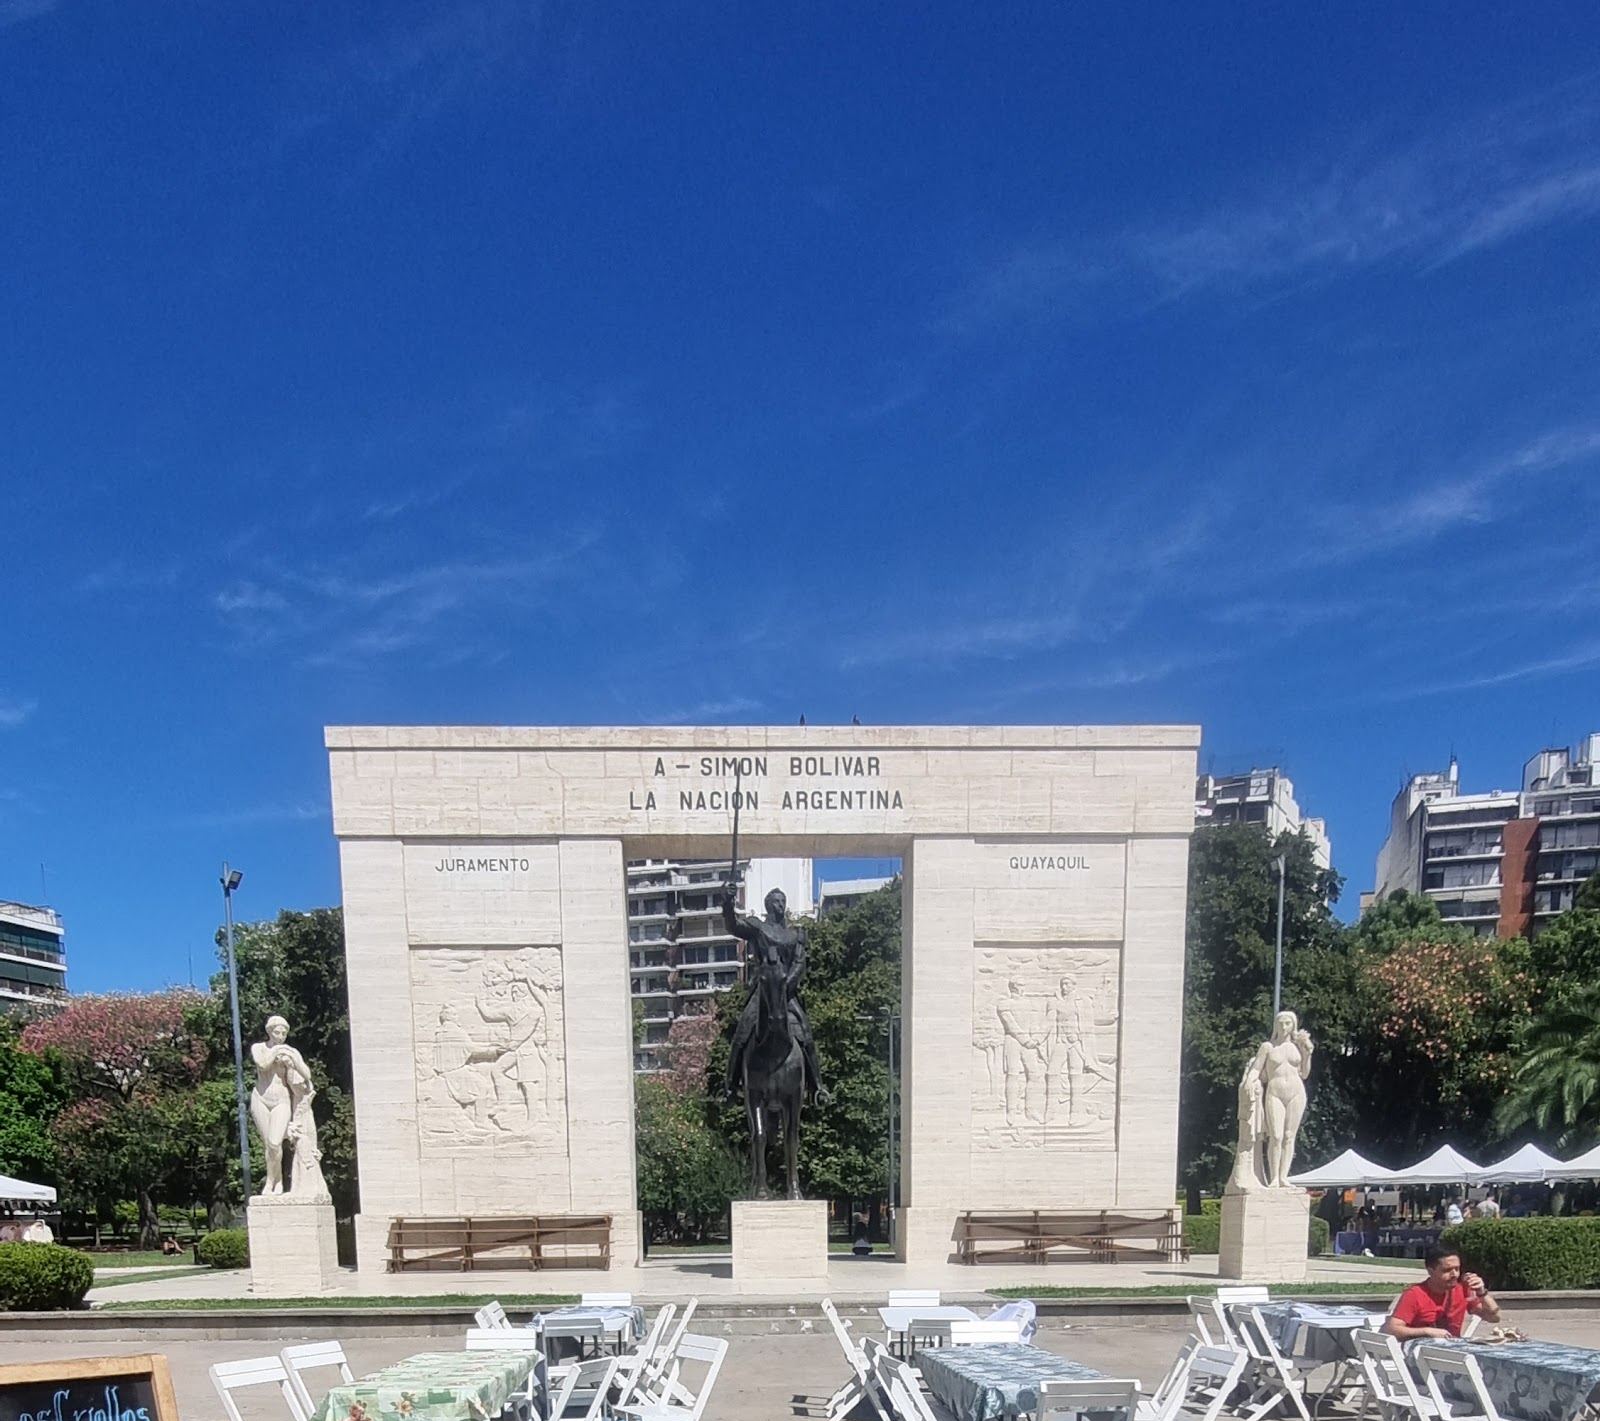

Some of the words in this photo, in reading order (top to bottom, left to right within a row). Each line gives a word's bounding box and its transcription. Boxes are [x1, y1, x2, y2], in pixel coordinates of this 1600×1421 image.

[654, 757, 666, 777] A
[700, 757, 768, 777] SIMON
[790, 757, 881, 777] BOLIVAR
[629, 791, 657, 811] LA
[680, 790, 759, 811] NACION
[782, 790, 904, 810] ARGENTINA
[435, 858, 530, 873] JURAMENTO
[1009, 856, 1091, 871] GUAYAQUIL
